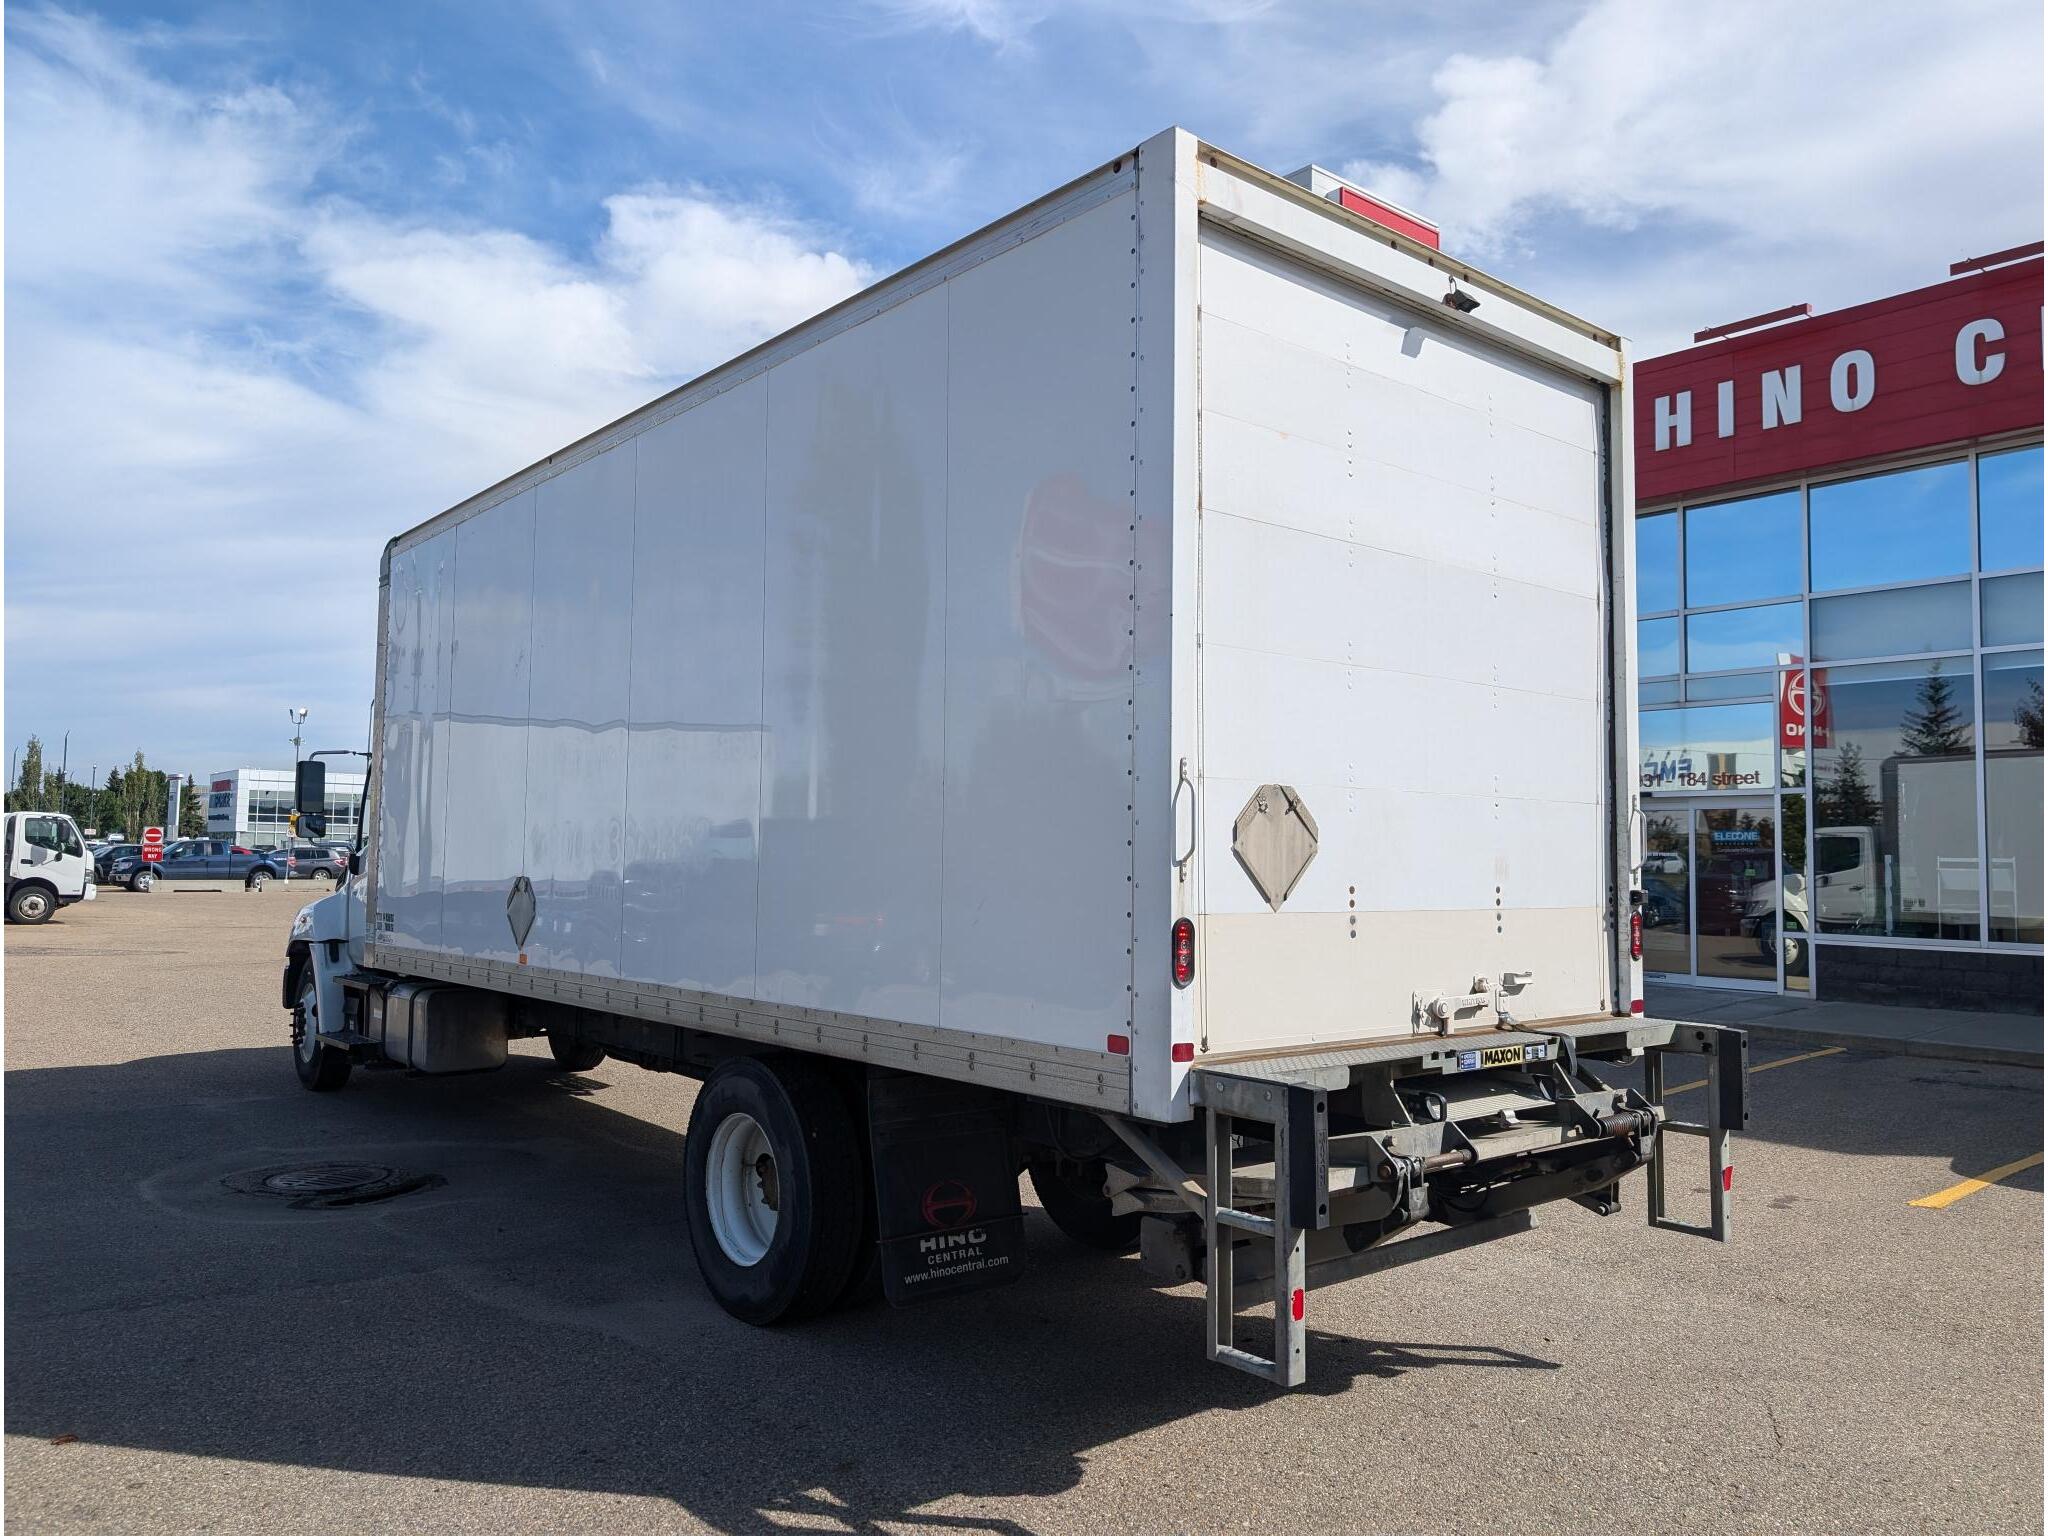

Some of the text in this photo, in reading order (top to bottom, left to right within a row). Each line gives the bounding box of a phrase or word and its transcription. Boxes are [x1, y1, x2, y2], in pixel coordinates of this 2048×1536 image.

[1655, 304, 2044, 452] HINO C
[1679, 772, 1707, 787] 184
[1712, 770, 1761, 786] street
[1484, 1047, 1521, 1065] MAXON
[920, 1229, 987, 1253] HINO
[927, 1247, 983, 1265] CENTRAL
[904, 1256, 1009, 1284] www.hinocentral.com
